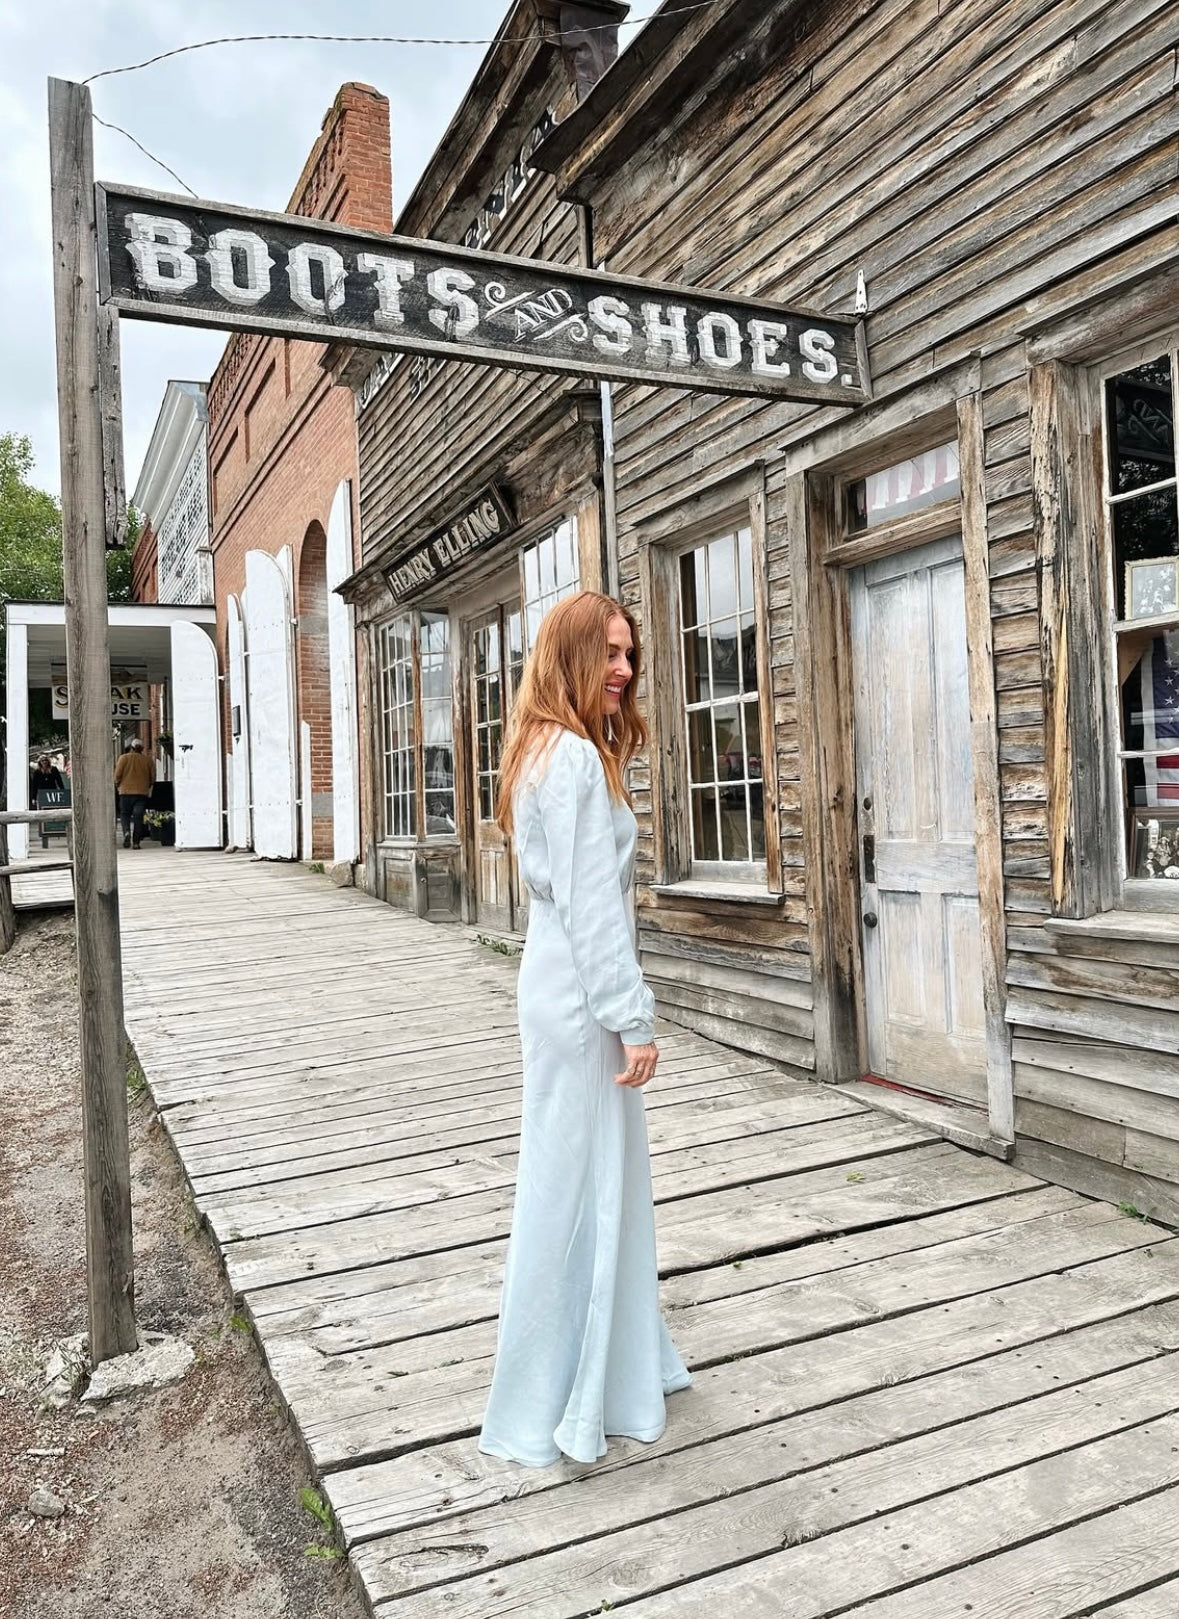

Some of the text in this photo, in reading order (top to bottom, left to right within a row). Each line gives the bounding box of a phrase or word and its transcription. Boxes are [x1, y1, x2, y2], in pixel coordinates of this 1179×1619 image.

[124, 212, 855, 387] BOOTS AND SHOES.
[388, 500, 500, 598] HENRY ELLING
[55, 686, 142, 707] SAK
[111, 703, 141, 716] USE
